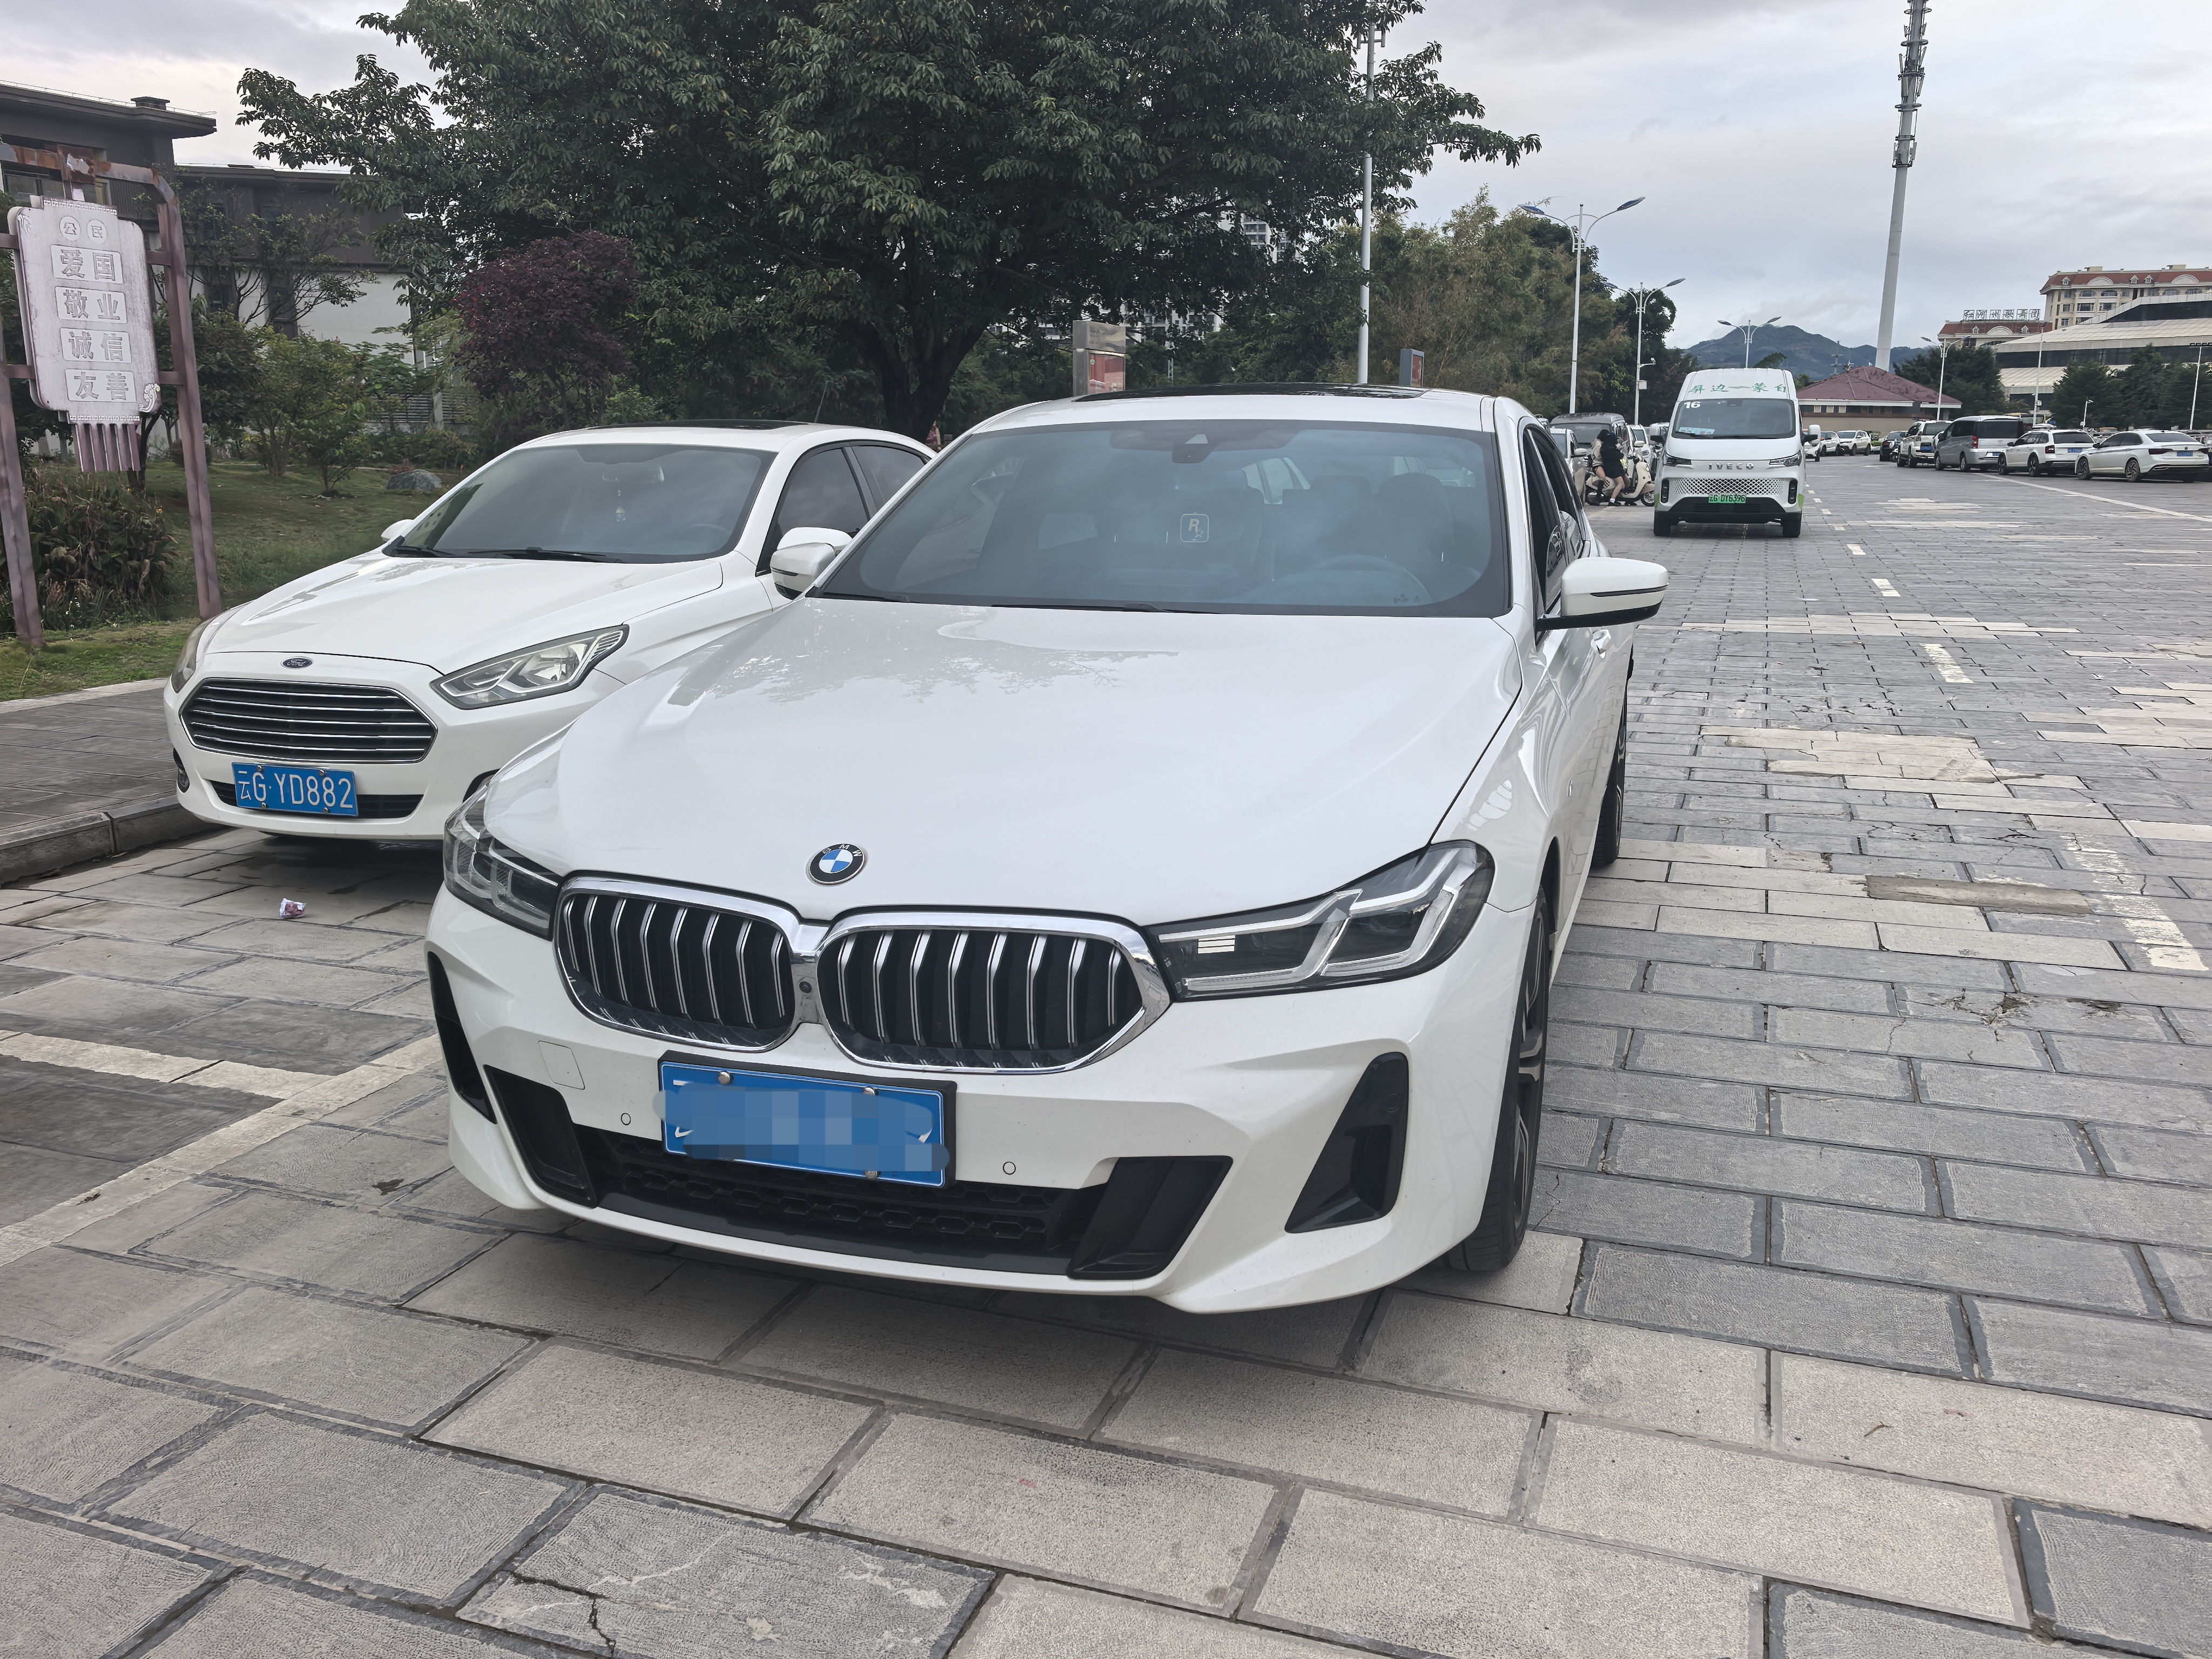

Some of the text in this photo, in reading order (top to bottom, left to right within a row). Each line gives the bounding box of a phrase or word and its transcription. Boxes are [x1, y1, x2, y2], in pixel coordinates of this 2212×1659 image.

[63, 222, 103, 238] 公民
[60, 249, 116, 281] 爱国
[63, 289, 120, 320] 敬业
[68, 331, 124, 361] 诚信
[73, 371, 129, 401] 友善
